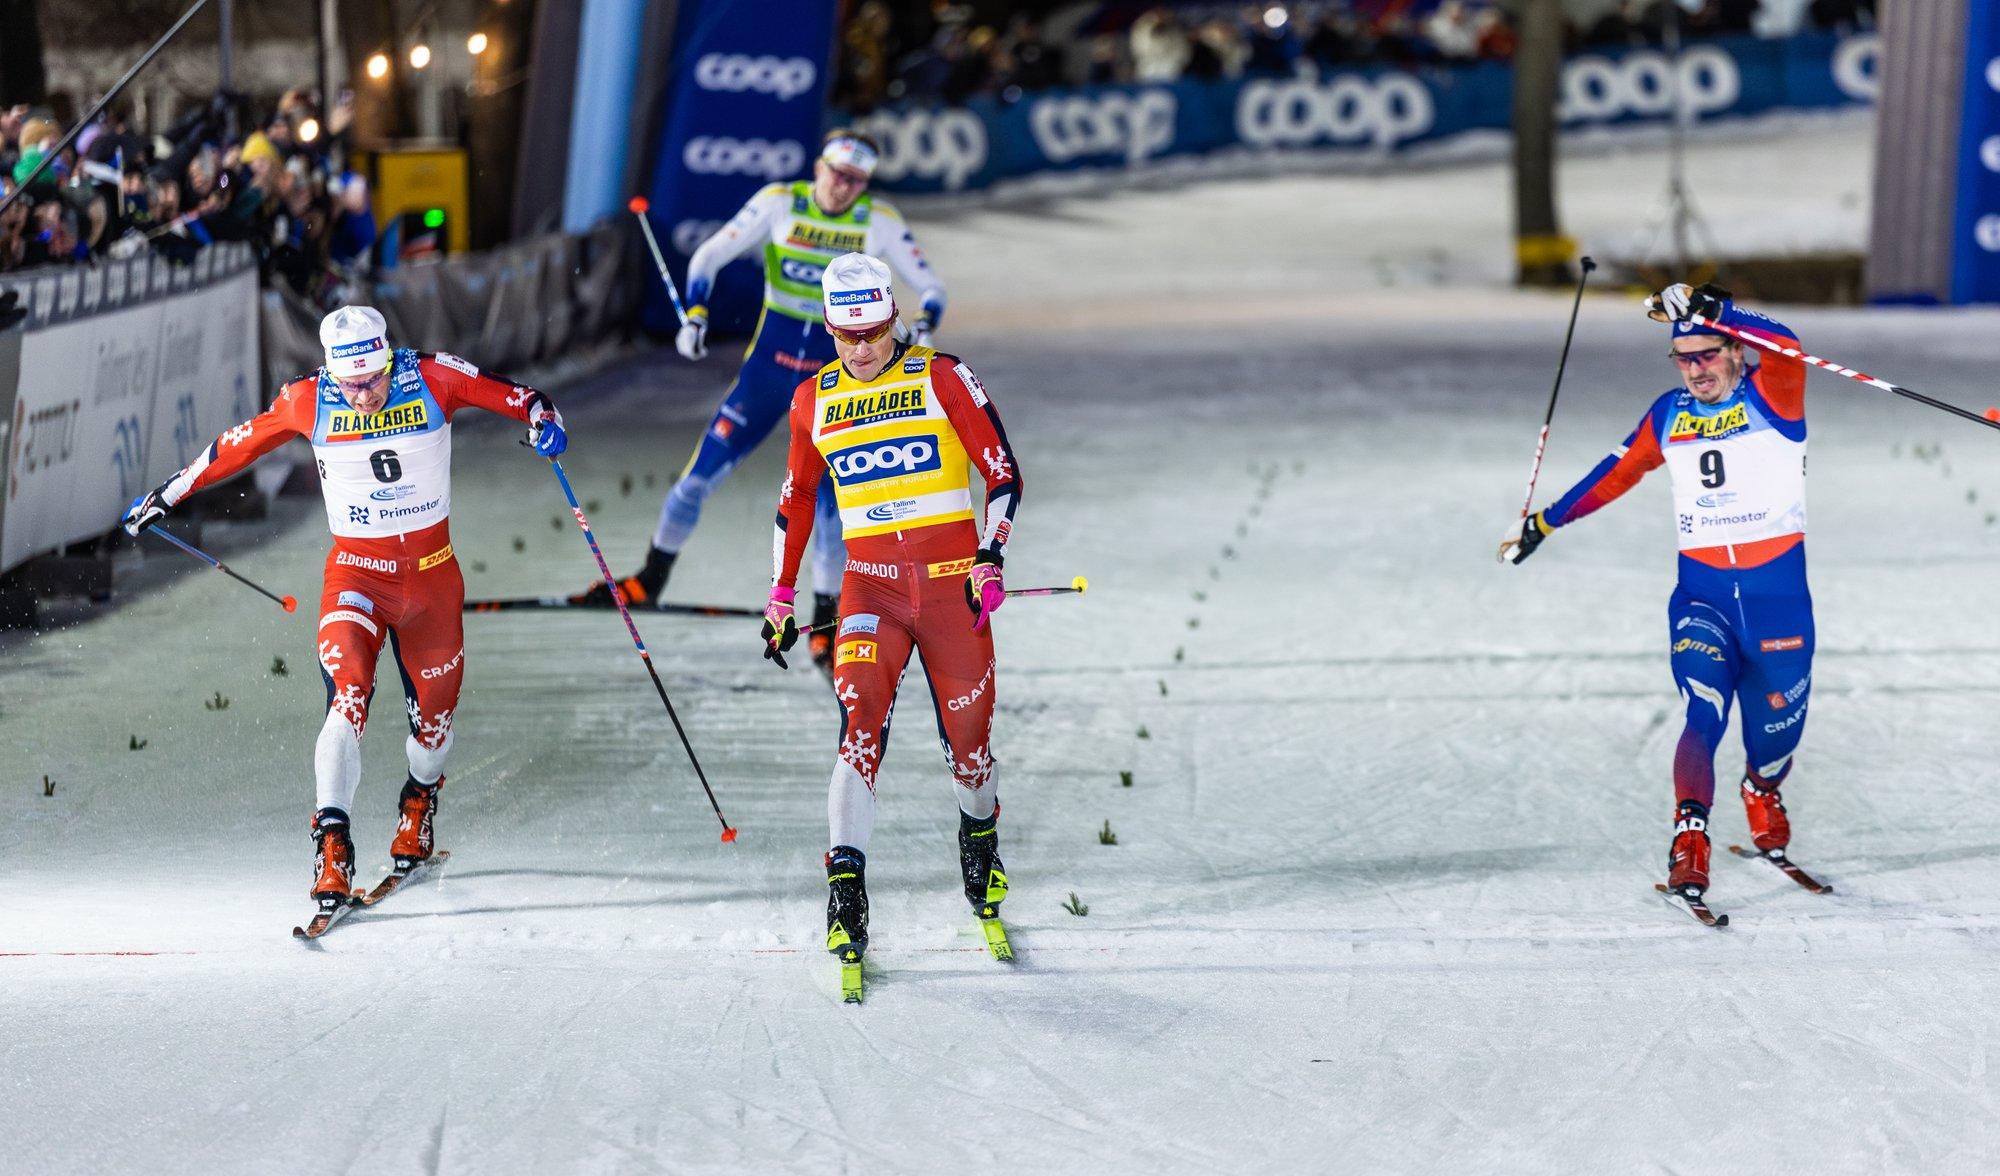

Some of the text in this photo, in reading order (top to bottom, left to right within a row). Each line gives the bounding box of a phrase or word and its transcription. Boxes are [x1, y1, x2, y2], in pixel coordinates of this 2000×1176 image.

[695, 52, 816, 101] coop
[1555, 45, 1740, 132] oop
[1236, 70, 1434, 146] coop
[683, 135, 805, 181] coop
[866, 108, 988, 190] oop
[831, 292, 872, 305] SpareBank
[332, 342, 374, 359] SpareBank
[333, 405, 424, 433] BLÅKLÄDER
[825, 389, 923, 424] BLÅKLÄDER
[864, 410, 914, 423] WORKWEAR
[373, 425, 418, 438] WORKWEAR
[369, 449, 403, 483] 6
[833, 441, 932, 478] coop
[1700, 449, 1726, 489] 9
[379, 497, 440, 519] Primostar
[892, 499, 916, 508] Tallinn
[1701, 510, 1768, 527] Primostar
[336, 551, 397, 574] ELDORADO
[938, 560, 974, 575] DH
[421, 647, 465, 680] CRAFT
[948, 668, 993, 712] CRAFT
